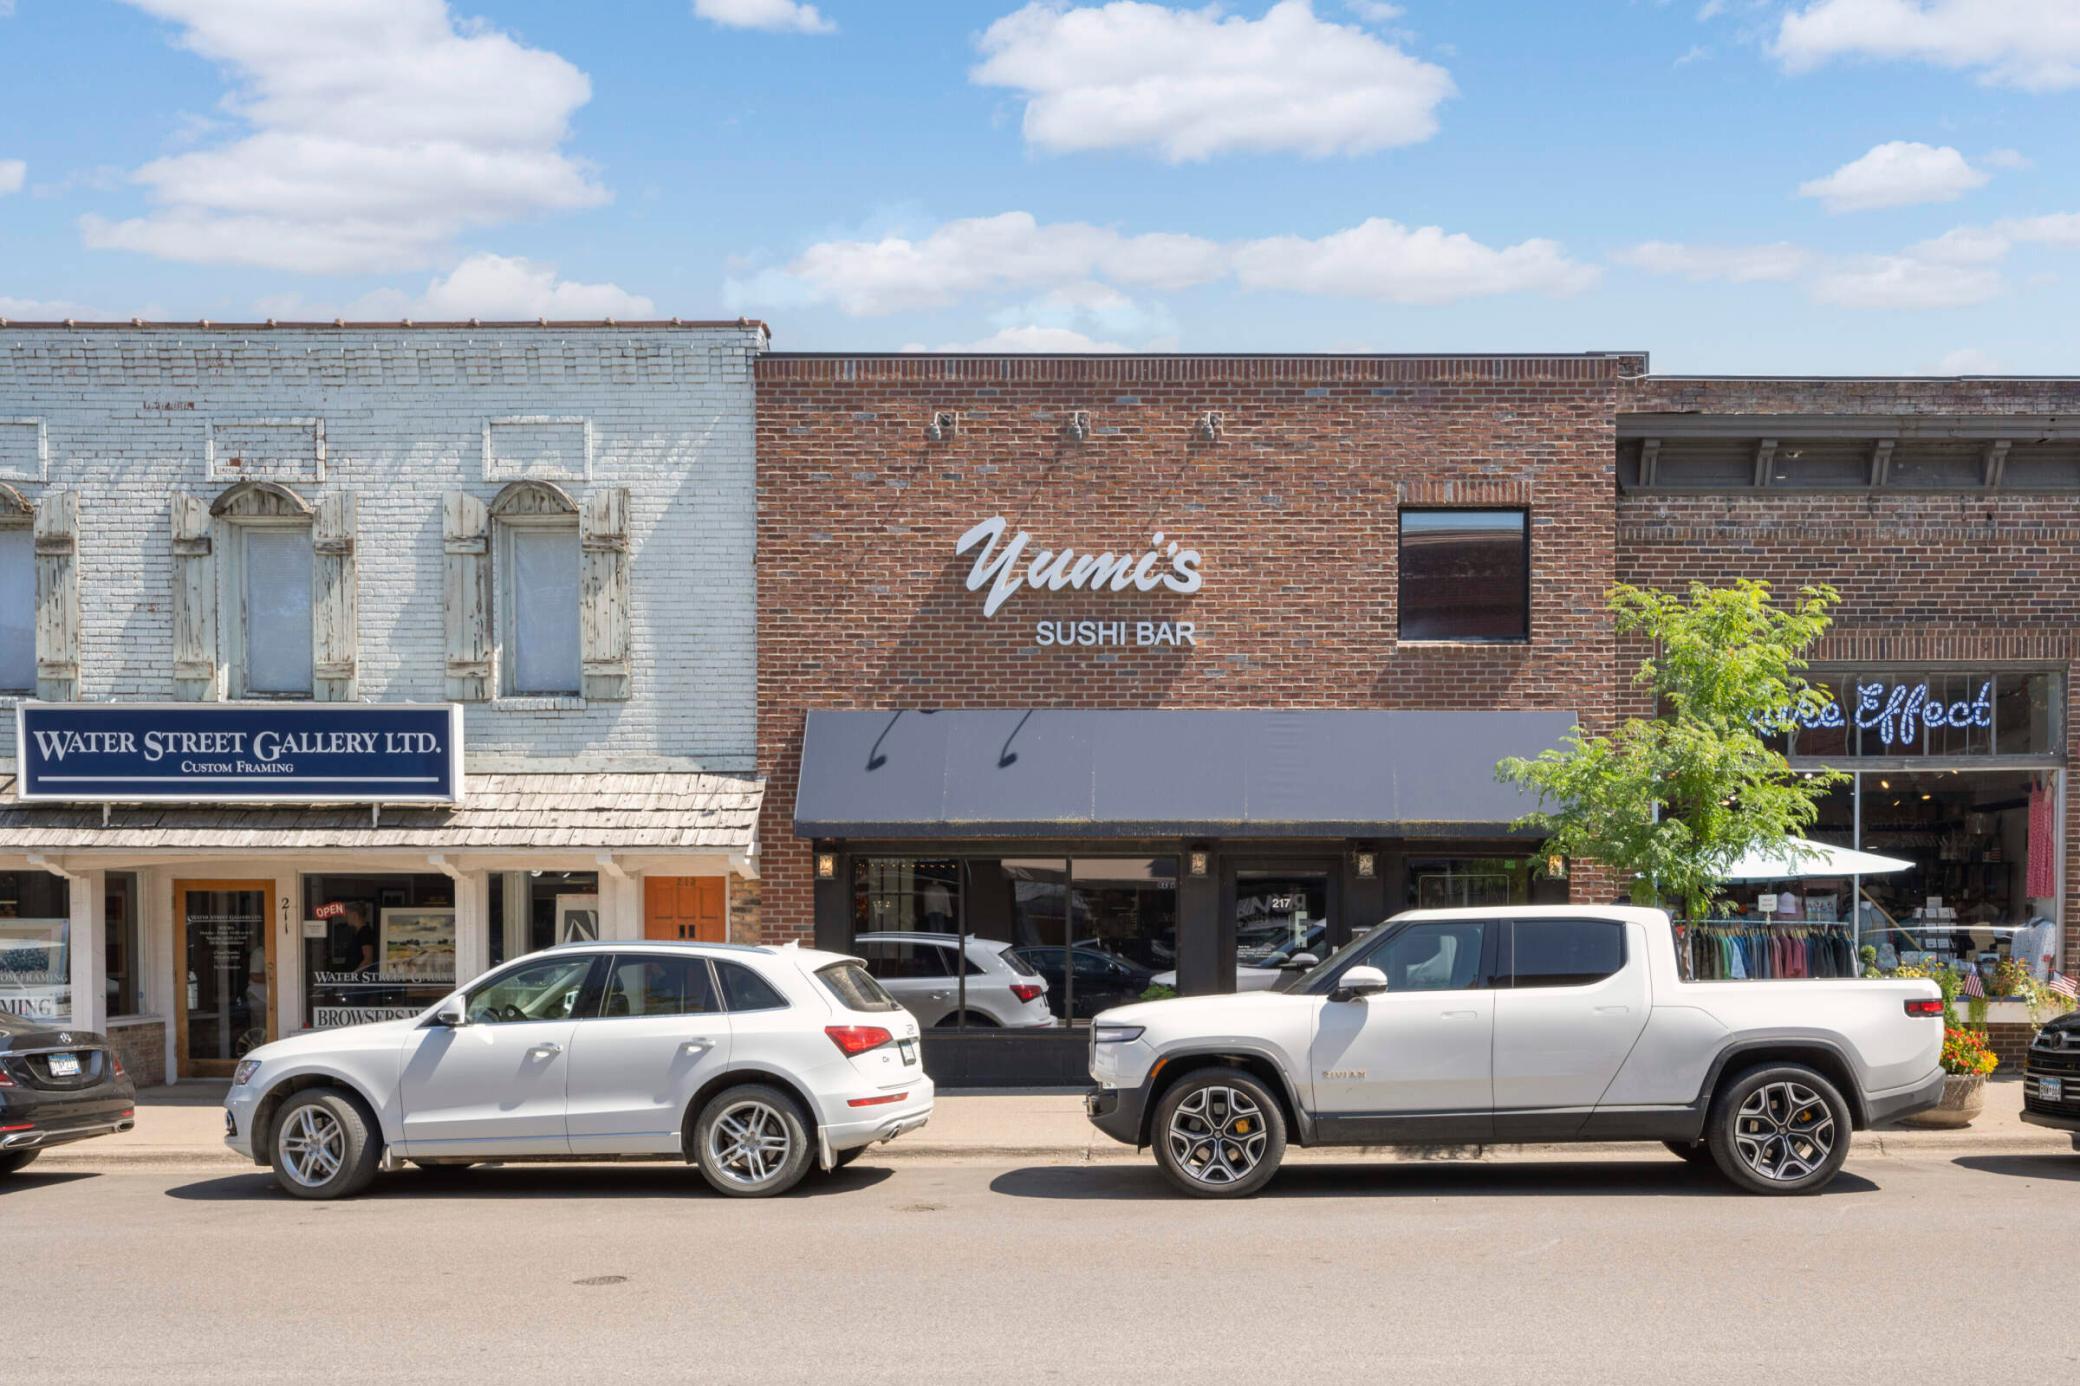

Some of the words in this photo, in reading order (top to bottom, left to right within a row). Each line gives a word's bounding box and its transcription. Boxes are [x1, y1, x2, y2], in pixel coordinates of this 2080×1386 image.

[955, 516, 1202, 618] Yumi's
[1035, 620, 1126, 646] SUSHI
[1136, 621, 1197, 646] BAR
[1854, 680, 1991, 745] Effect
[33, 731, 137, 762] WATER
[144, 731, 247, 762] STREET
[253, 731, 379, 762] GALLERY
[385, 732, 442, 754] LTD.
[181, 760, 233, 774] CUSTOM
[235, 760, 294, 774] FRAMING
[281, 897, 290, 936] 211
[316, 903, 344, 918] OPEN
[1272, 898, 1291, 909] 217
[314, 971, 359, 983] WATER
